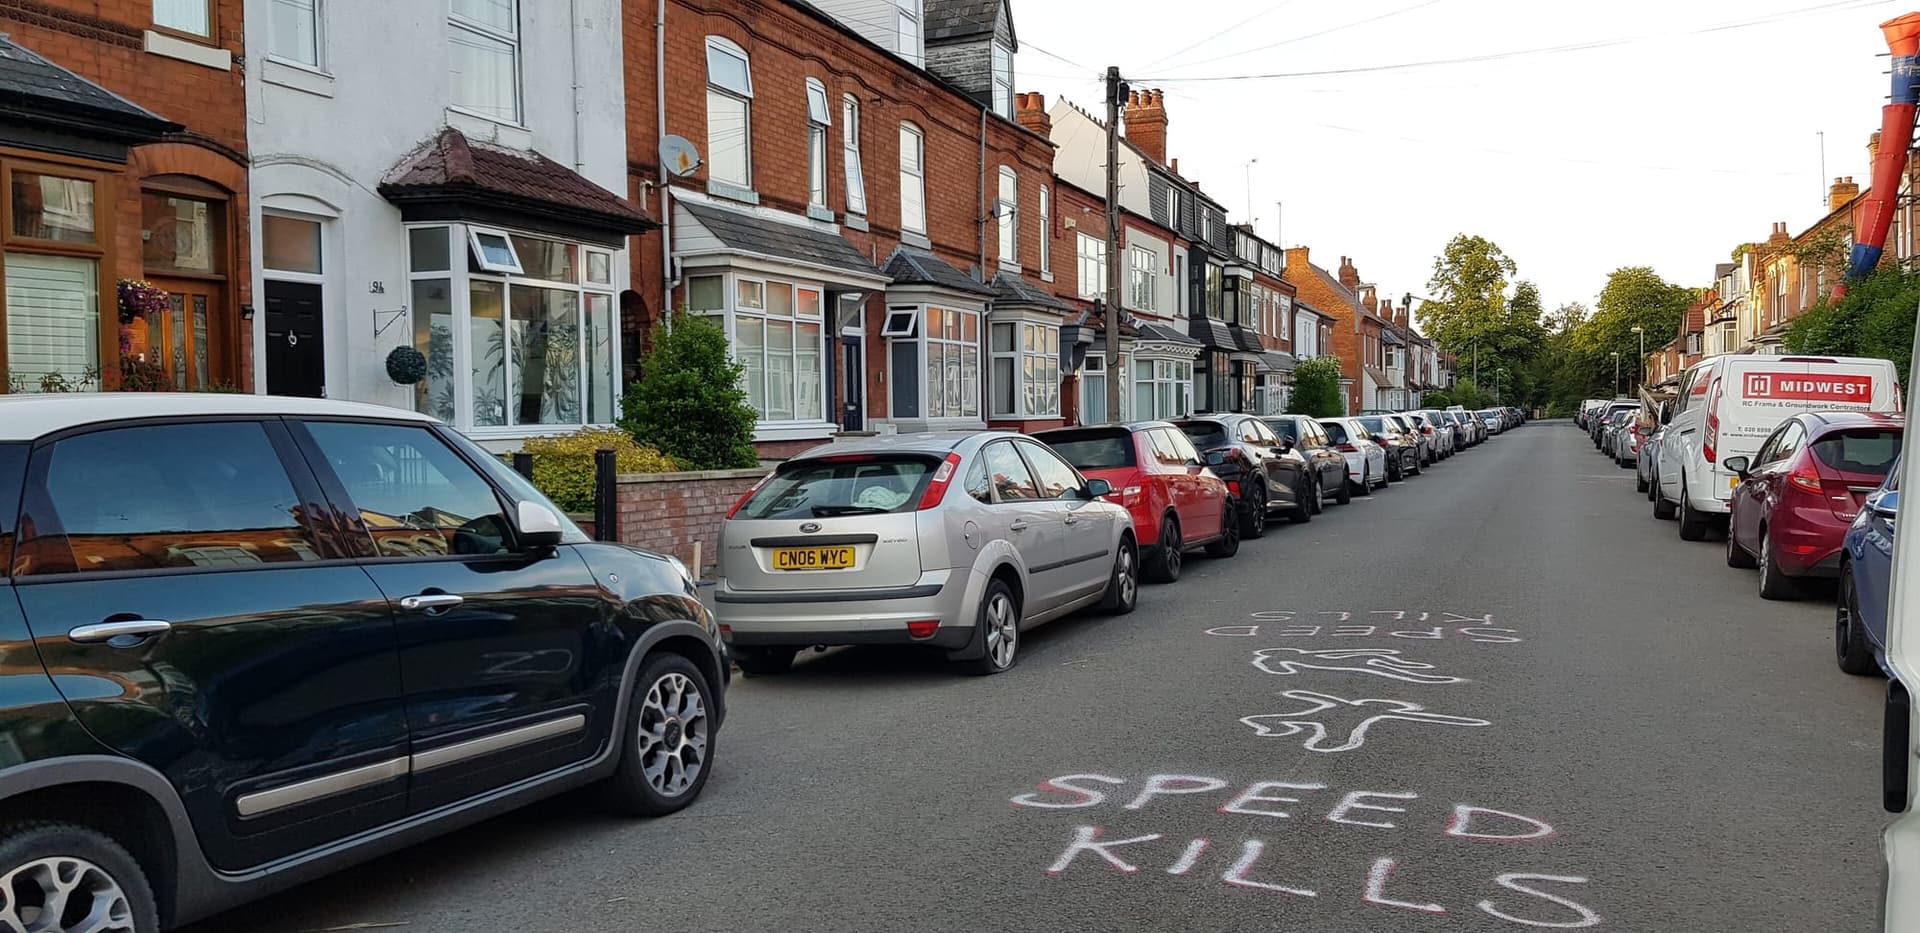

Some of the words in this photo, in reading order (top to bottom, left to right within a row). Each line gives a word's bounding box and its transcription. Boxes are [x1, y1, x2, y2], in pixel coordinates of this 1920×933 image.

[1780, 380, 1867, 395] MIDWEST
[1785, 401, 1828, 410] Groundwork
[779, 551, 816, 567] CN06
[820, 550, 849, 564] WYC
[1204, 625, 1523, 643] SPEED
[1010, 773, 1554, 842] SPEED
[1047, 825, 1601, 929] KILLS
